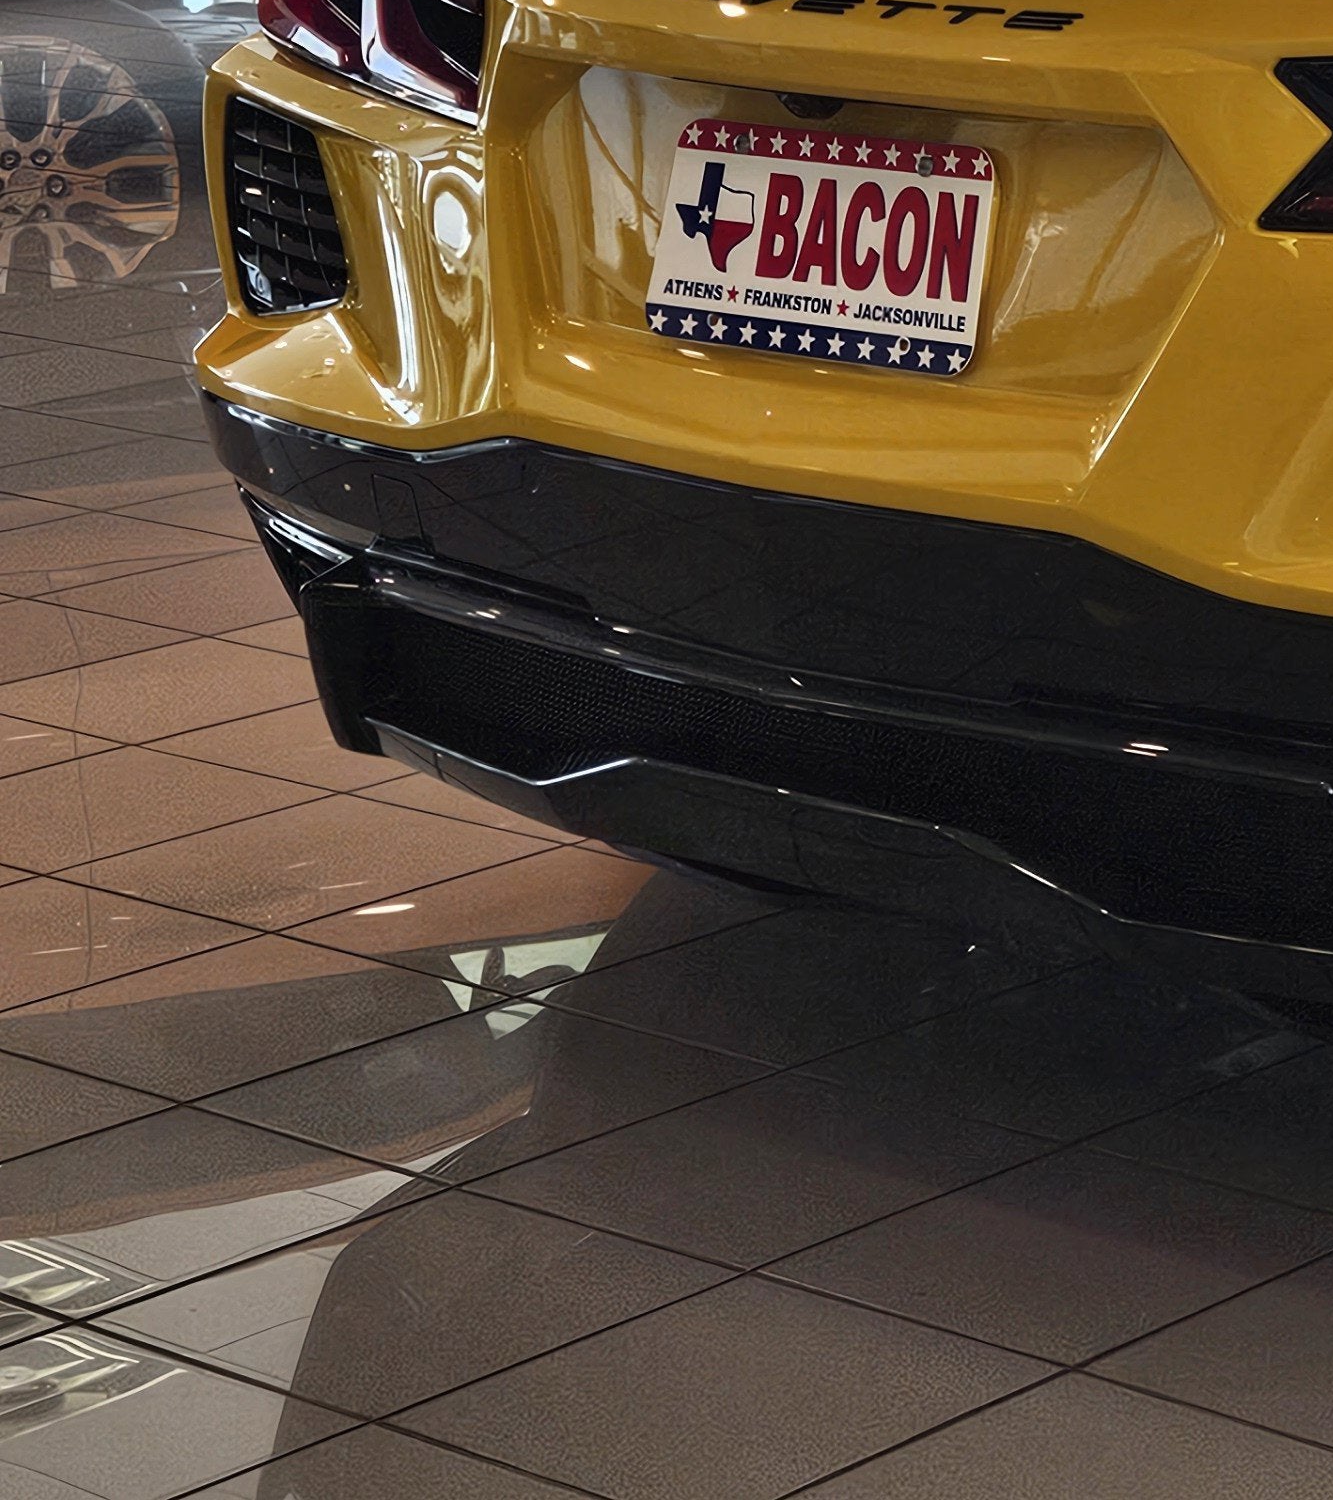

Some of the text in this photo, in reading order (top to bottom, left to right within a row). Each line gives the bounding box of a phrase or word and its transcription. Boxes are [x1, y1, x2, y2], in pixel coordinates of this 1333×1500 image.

[754, 171, 980, 304] BACON
[662, 277, 967, 334] ATHENS FRANKSTON JACKSONVILLE
